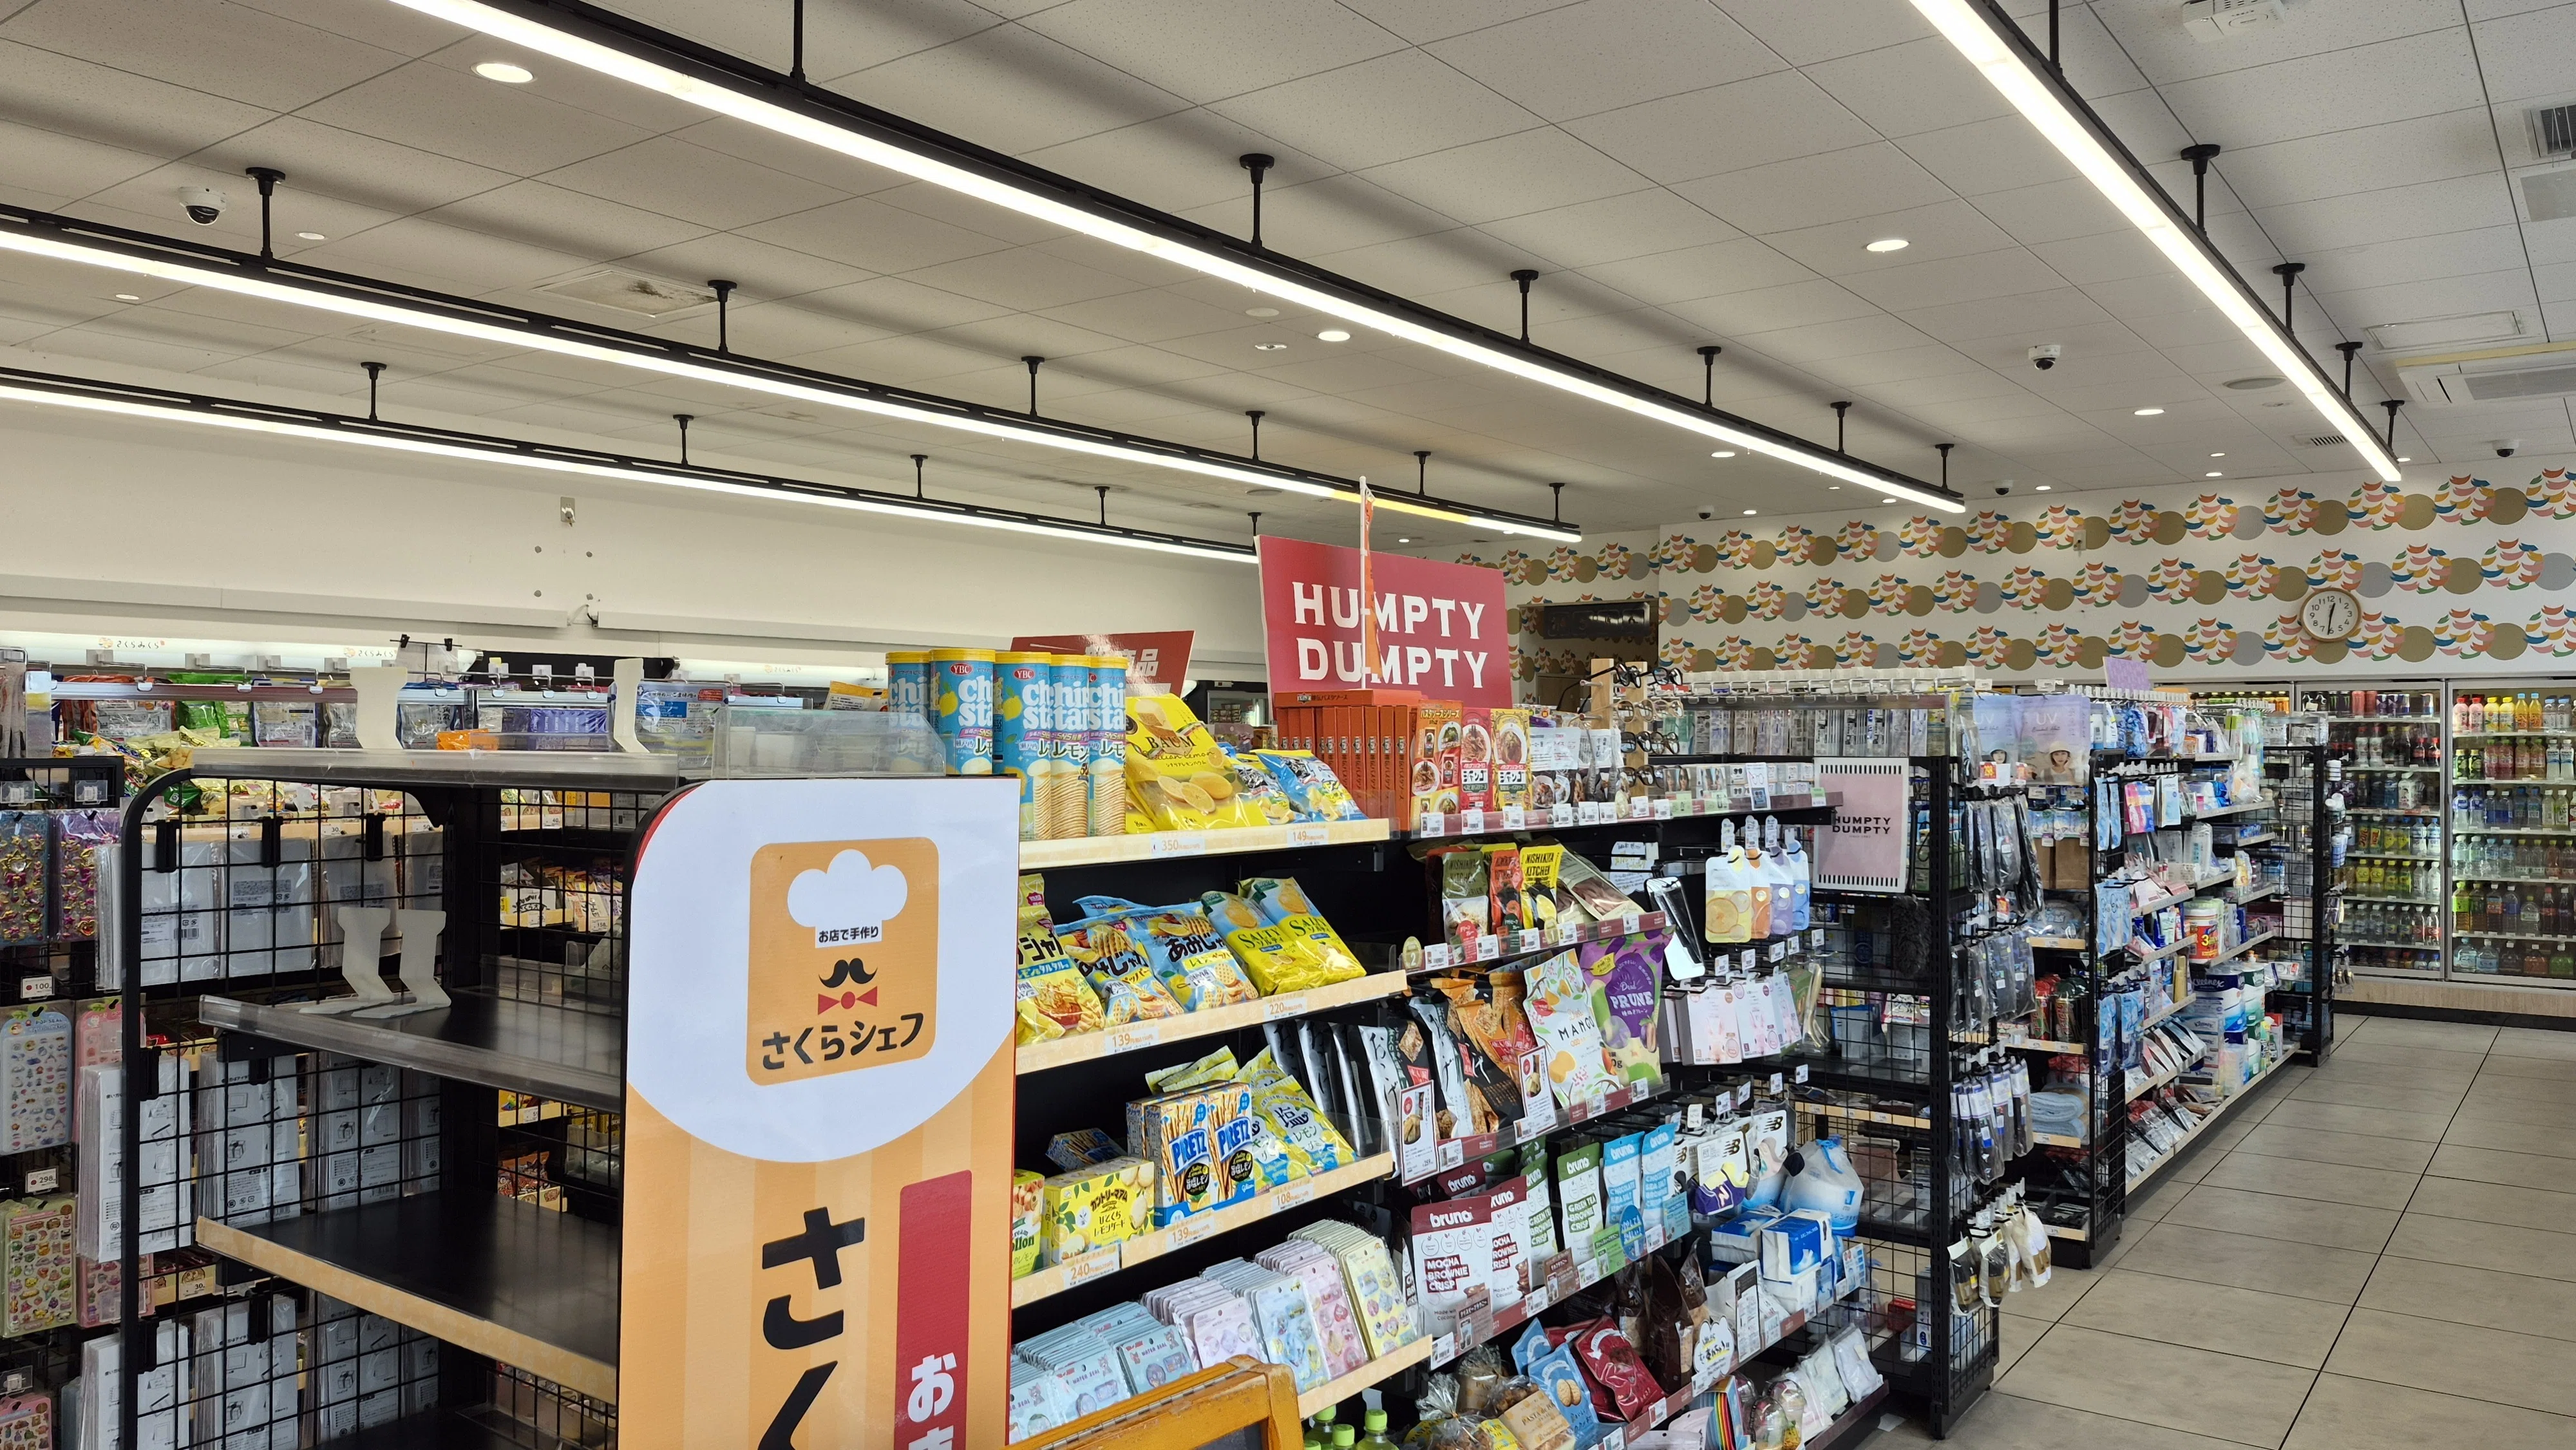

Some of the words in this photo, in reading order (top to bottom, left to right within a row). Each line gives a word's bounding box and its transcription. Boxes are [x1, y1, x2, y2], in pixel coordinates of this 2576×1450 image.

[1292, 581, 1485, 639] HUMPTY
[952, 664, 972, 674] YBC
[1296, 637, 1488, 688] DUMPTY
[2036, 712, 2058, 724] UV
[1146, 734, 1197, 749] BAUM
[1834, 816, 1891, 825] HUMPTY
[1293, 831, 1307, 842] 149
[1832, 825, 1891, 834] DUMPTY
[819, 925, 879, 943] お店で手作り
[1237, 928, 1281, 949] SALTY
[1410, 954, 1417, 965] 2
[1609, 991, 1654, 1010] PRUNE
[1269, 1004, 1284, 1015] 220
[1557, 1015, 1595, 1041] MANGO
[761, 1012, 925, 1070] さくらシェフ
[1112, 1033, 1130, 1048] 139
[1274, 1106, 1309, 1129] 塩
[1217, 1119, 1251, 1158] PRETZ
[1293, 1125, 1318, 1142] レモン
[1171, 1131, 1208, 1171] PRETZ
[1611, 1144, 1636, 1160] bruno
[1566, 1156, 1590, 1174] bruno
[39, 1175, 55, 1184] 298
[1448, 1174, 1477, 1192] bruno
[1090, 1187, 1128, 1211] カントリーマアム
[1276, 1192, 1291, 1204] 108
[1568, 1199, 1586, 1212] GREEN
[1586, 1196, 1596, 1205] TEA
[1430, 1209, 1473, 1229] bruno
[1570, 1220, 1590, 1233] CRISP
[1172, 1226, 1189, 1243] 139
[1426, 1257, 1460, 1270] MOCHA
[1070, 1263, 1090, 1281] 240
[1427, 1266, 1469, 1280] BROWNIE
[1428, 1280, 1456, 1292] CRISP
[1157, 1342, 1168, 1351] SEAL
[1089, 1369, 1100, 1379] SEAL
[1018, 1398, 1030, 1408] SEAL
